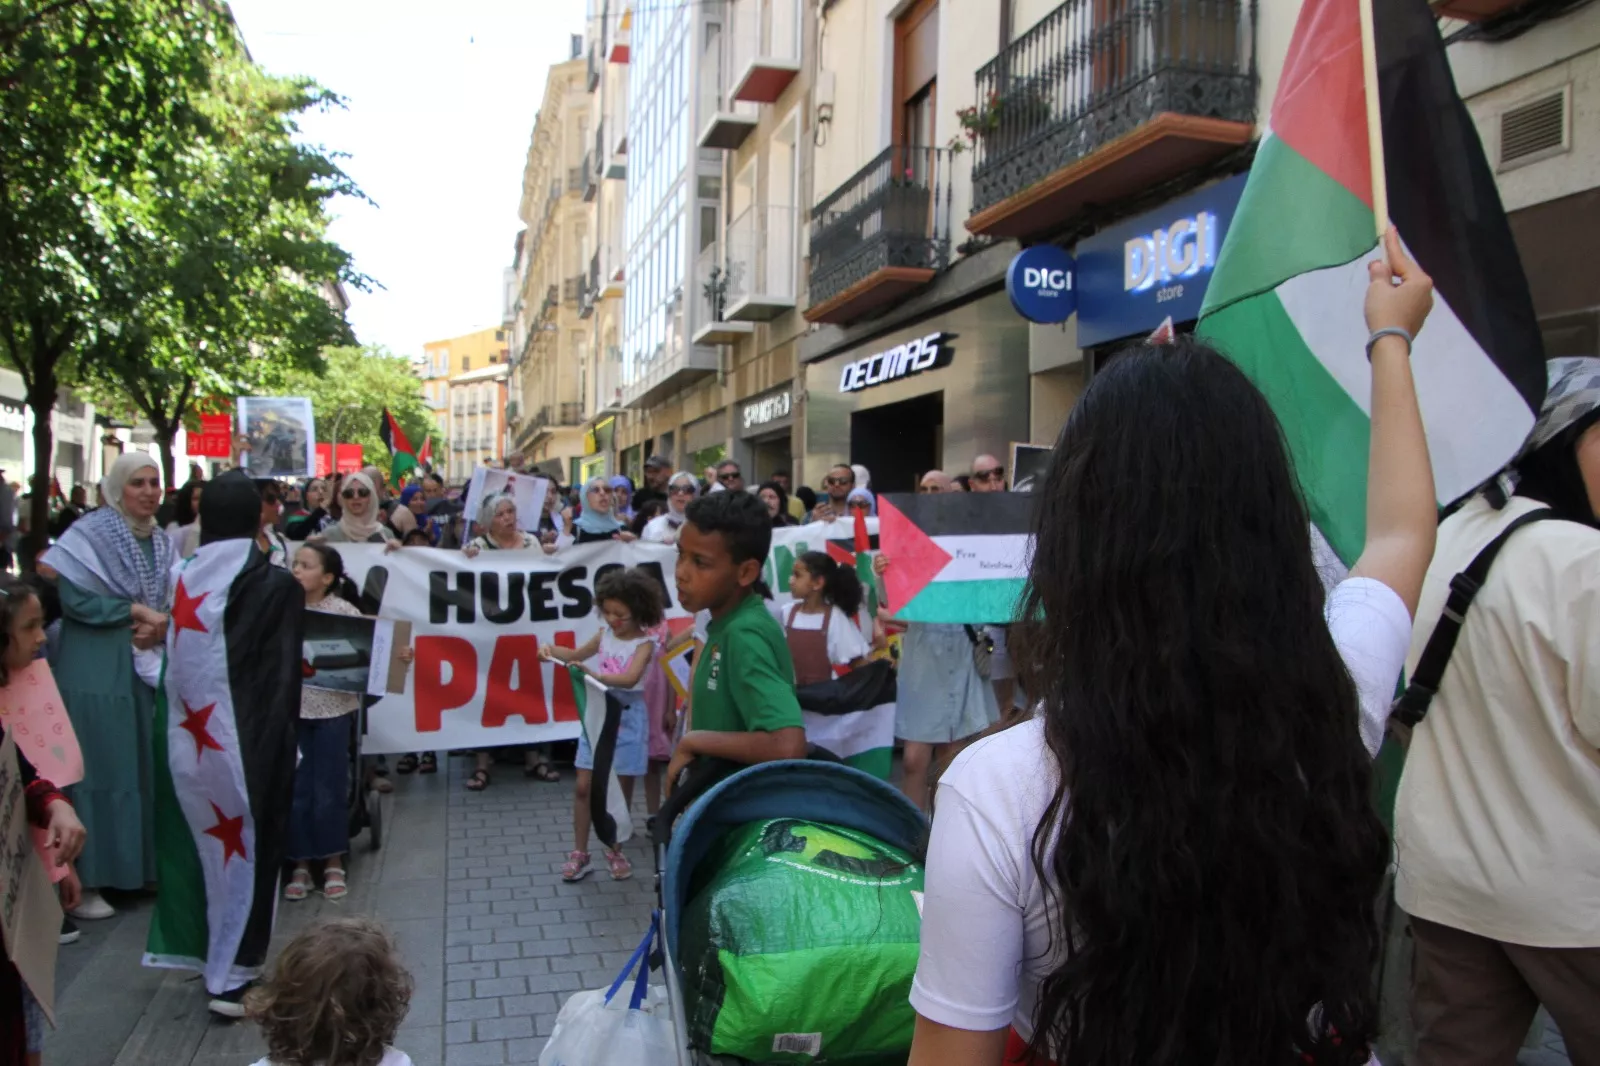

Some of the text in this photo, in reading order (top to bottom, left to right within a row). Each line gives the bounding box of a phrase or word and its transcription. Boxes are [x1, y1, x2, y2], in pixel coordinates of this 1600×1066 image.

[1124, 212, 1212, 291] DIGI
[1024, 267, 1072, 290] DIGI
[1037, 288, 1059, 298] store
[1157, 284, 1183, 303] store
[839, 331, 941, 393] DECIMAS
[956, 549, 976, 559] Free
